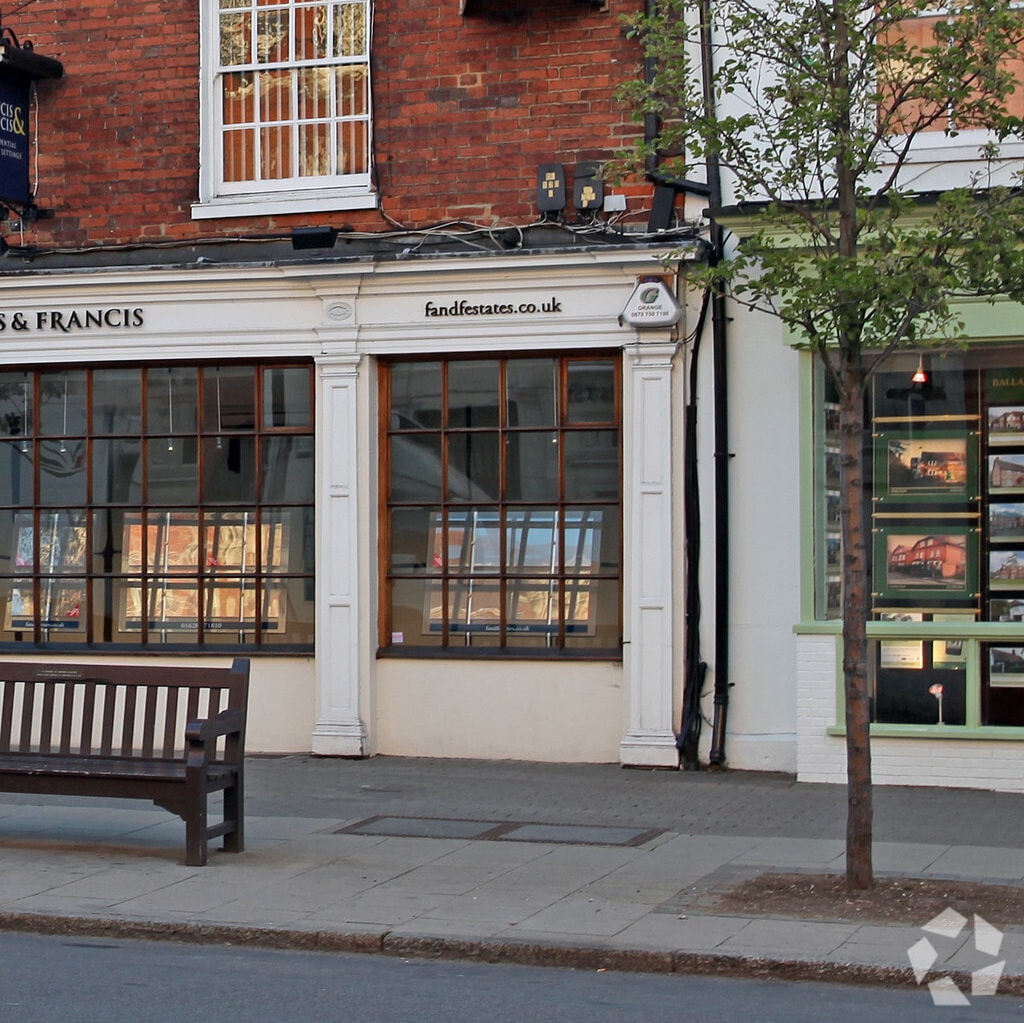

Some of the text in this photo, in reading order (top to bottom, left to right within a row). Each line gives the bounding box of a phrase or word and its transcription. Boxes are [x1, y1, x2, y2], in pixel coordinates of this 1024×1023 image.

[13, 106, 26, 136] &
[11, 311, 28, 331] &
[36, 307, 144, 333] FRANCIS
[424, 297, 562, 317] fandfestates.co.uk
